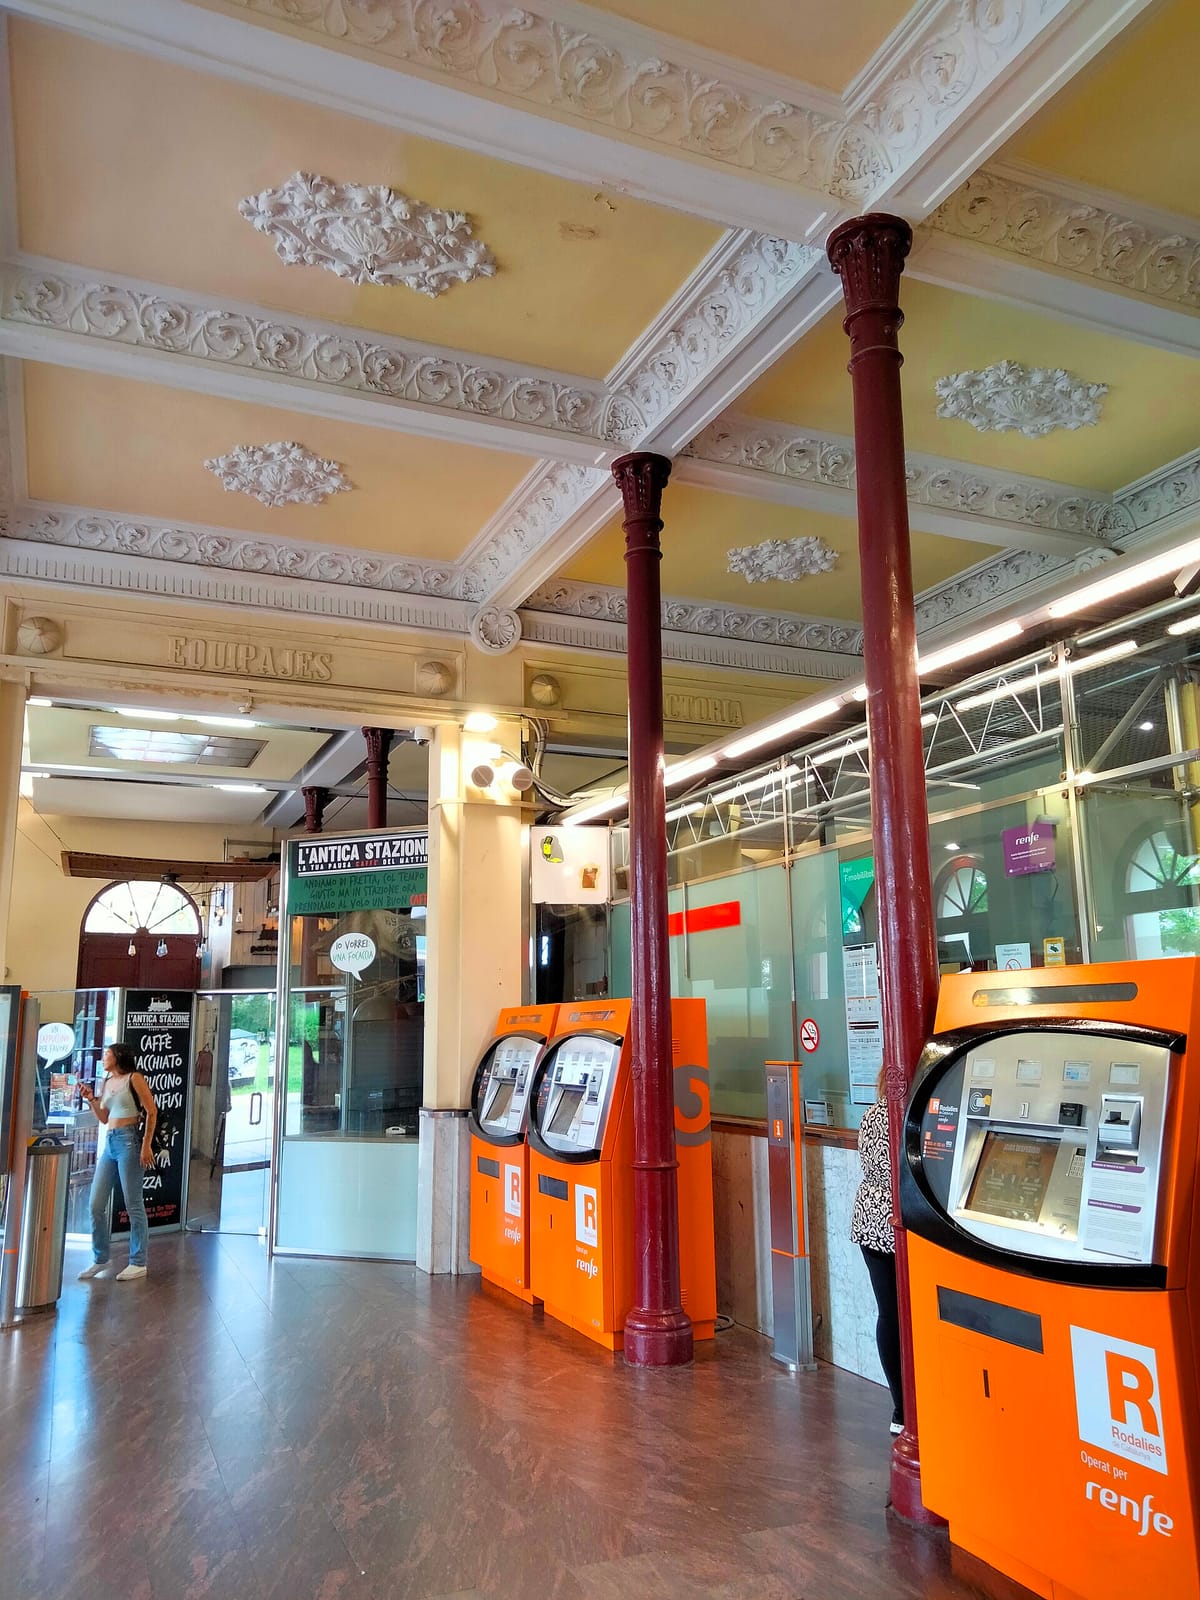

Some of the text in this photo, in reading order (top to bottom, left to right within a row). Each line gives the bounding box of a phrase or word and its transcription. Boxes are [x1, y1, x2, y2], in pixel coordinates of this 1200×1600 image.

[168, 635, 332, 681] EQUIPAJES
[664, 694, 745, 725] CTORIA
[1015, 832, 1040, 846] renfe
[299, 844, 359, 865] L'ANTICA
[311, 863, 325, 871] TUA
[328, 861, 352, 869] PAUSA
[383, 857, 396, 865] DEL
[400, 855, 428, 864] MATTIN
[304, 879, 337, 889] ANDIAMO
[340, 877, 347, 886] DI
[399, 871, 425, 882] TEMPO
[310, 882, 417, 900] GIUSTO MA IN STAZIONE ORA
[294, 900, 336, 912] PRENDIAMO
[351, 898, 370, 909] VOLO
[373, 897, 384, 908] UN
[386, 894, 408, 907] BUON
[336, 939, 369, 950] IO VORREI
[333, 950, 374, 962] UNA FOCACCIA
[127, 1014, 190, 1023] L'ANTICA STAZIONE
[140, 1033, 173, 1052] CAFFÈ
[154, 1092, 183, 1111] NFUSI
[142, 1175, 162, 1190] ZZA
[511, 1172, 520, 1203] R
[584, 1194, 596, 1230] R
[505, 1226, 521, 1246] renfe
[576, 1257, 598, 1280] renfe
[1105, 1350, 1160, 1437] R
[1112, 1425, 1162, 1457] Rodalies
[1080, 1450, 1128, 1480] Operat per
[1086, 1481, 1175, 1537] renfe
